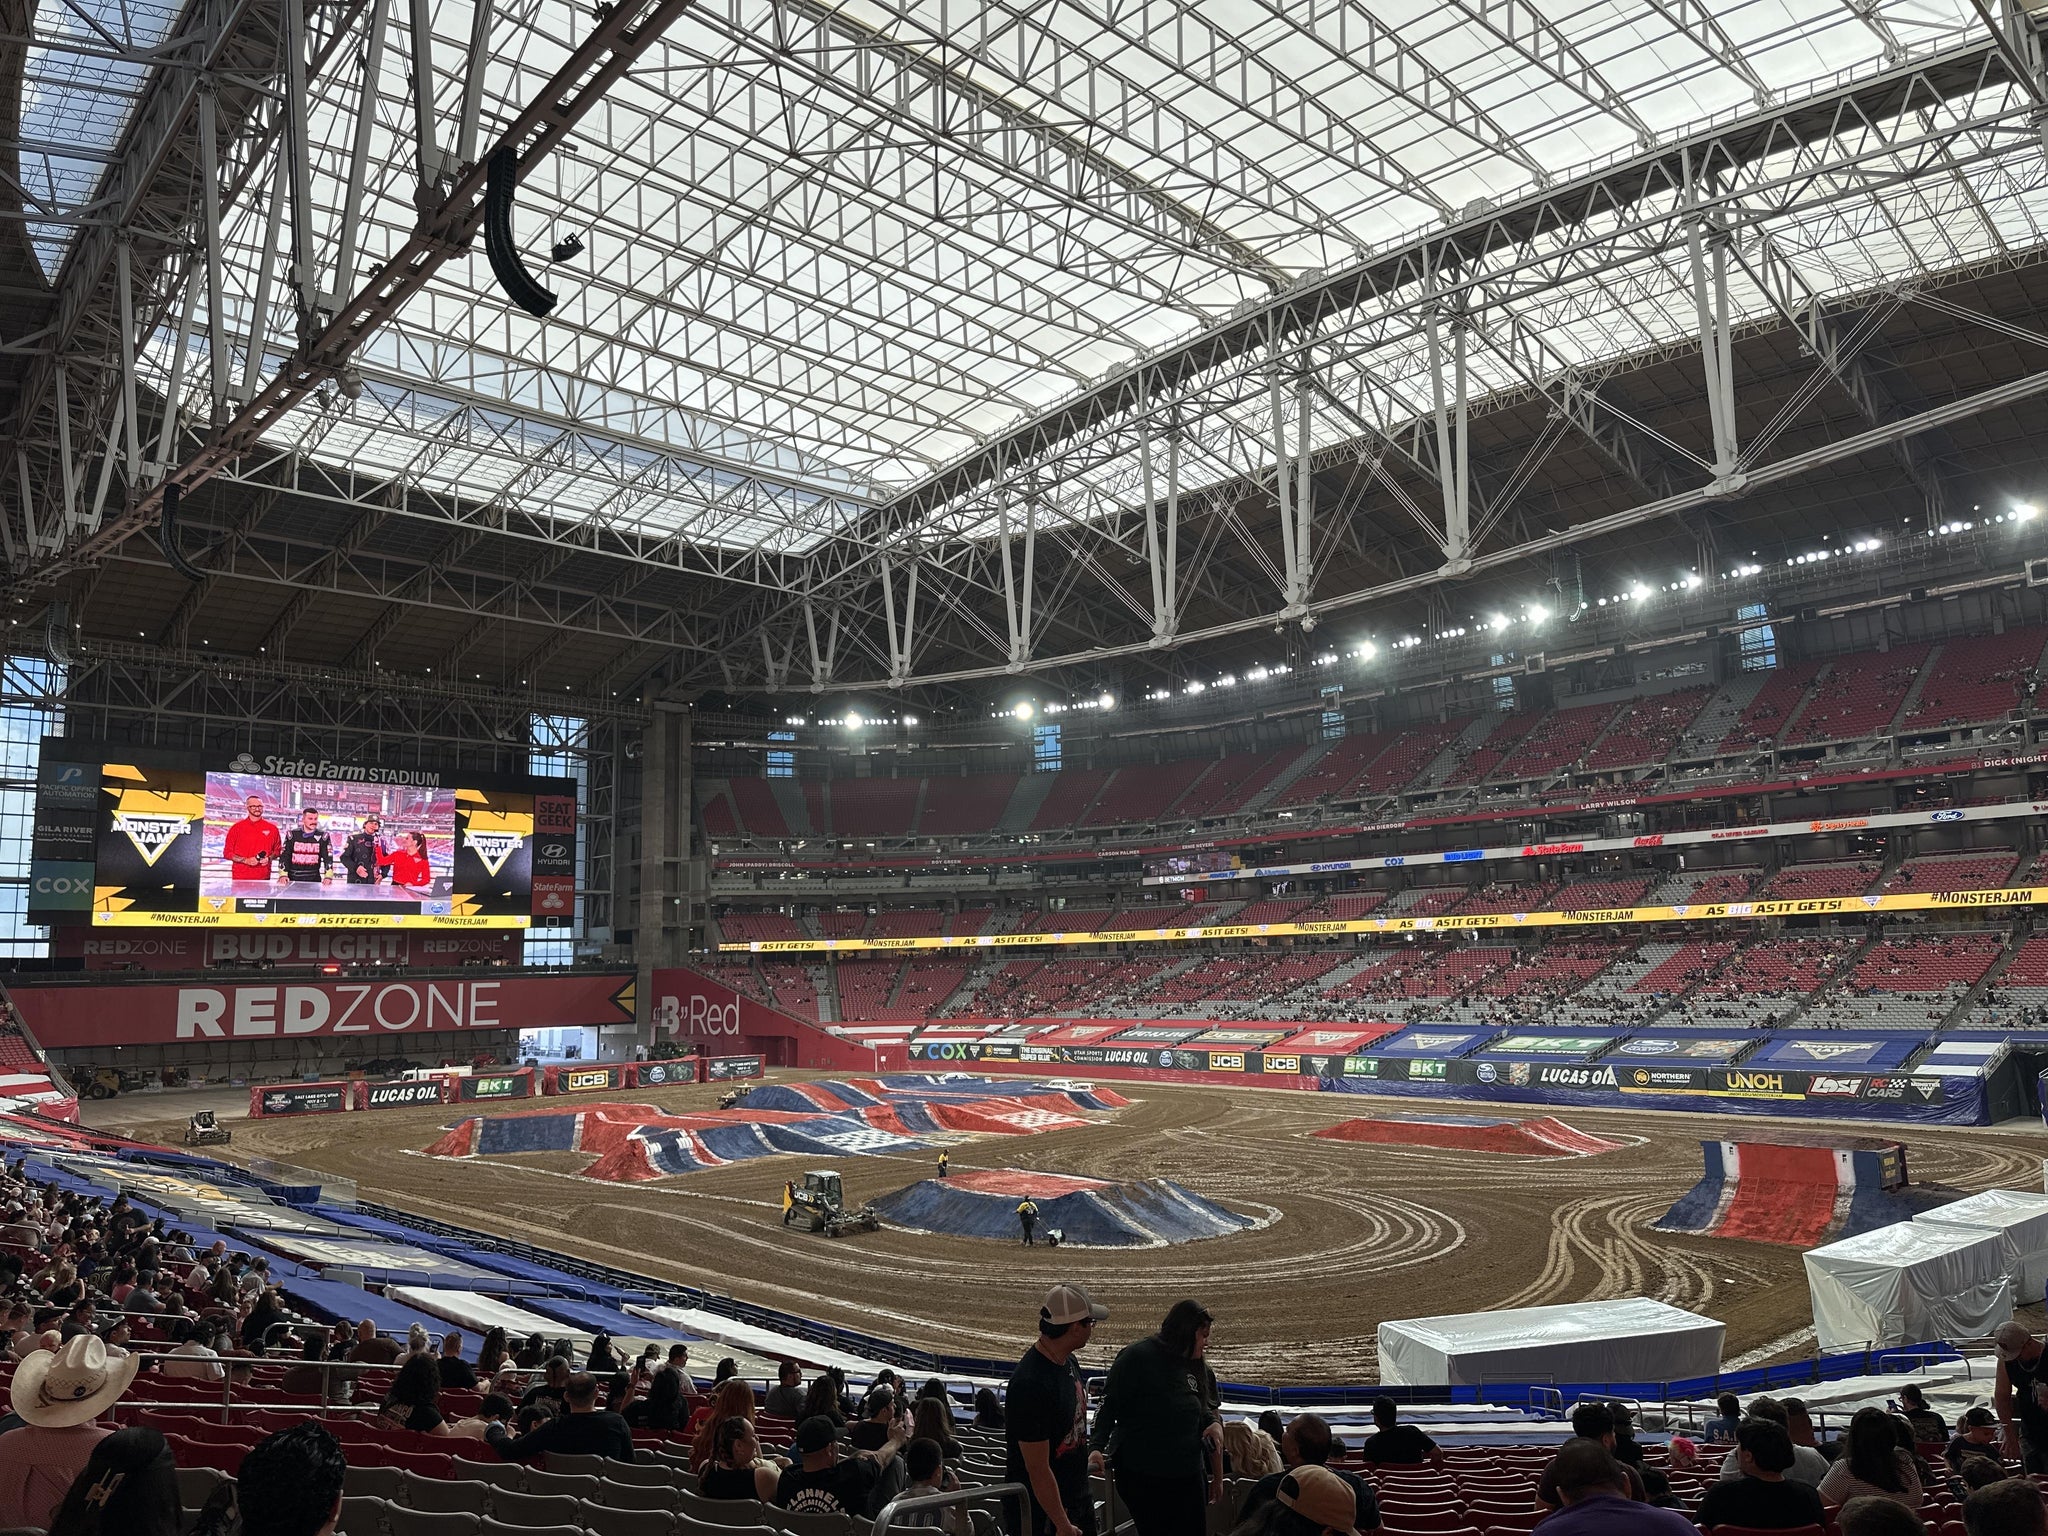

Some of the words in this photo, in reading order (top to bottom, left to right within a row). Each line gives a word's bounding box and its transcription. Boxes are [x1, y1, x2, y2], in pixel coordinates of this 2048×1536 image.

[1984, 759, 2009, 767] DICK
[2011, 755, 2048, 765] (NIGHT
[368, 768, 440, 787] STADIUM
[40, 783, 68, 792] PACIFIC
[43, 790, 95, 799] AUTOMATION
[538, 802, 572, 816] SEAT
[1580, 802, 1605, 810] LARRY
[1607, 798, 1636, 807] WILSON
[538, 814, 572, 828] GEEK
[112, 820, 192, 836] MONSTER
[132, 833, 172, 845] JAM
[464, 837, 523, 850] MONSTER
[480, 848, 507, 858] JAM
[536, 858, 571, 866] HYUNDAI
[1384, 857, 1404, 866] COX
[36, 877, 90, 895] COX
[1930, 890, 2032, 904] #MONSTERJAM
[1706, 906, 1725, 916] AS
[1728, 904, 1752, 915] BIG
[1755, 902, 1775, 914] AS
[1778, 902, 1791, 912] IT
[1797, 900, 1842, 912] GETS!
[150, 914, 220, 924] #MONSTERJAM
[319, 916, 336, 924] AS
[336, 916, 348, 924] IT
[350, 916, 380, 925] GETS!
[433, 916, 488, 926] #MONSTERJAM
[1562, 910, 1634, 922] #MONSTERJAM
[1294, 922, 1347, 933] #MONSTERJAM
[1400, 920, 1414, 929] AS
[1436, 918, 1450, 927] AS
[1452, 918, 1463, 926] IT
[1465, 916, 1499, 926] GETS!
[1089, 932, 1136, 940] #MONSTERJAM
[1202, 928, 1213, 936] AS
[1224, 928, 1248, 936] GETS!
[83, 939, 188, 955] REDZONE
[212, 934, 294, 960] BUD
[298, 934, 403, 960] LIGHT
[423, 939, 502, 953] REDZONE
[863, 938, 916, 948] #MONSTERJAM
[176, 982, 501, 1038] REDZONE
[690, 994, 740, 1036] Red
[927, 1044, 967, 1060] COX
[1105, 1050, 1132, 1062] LUCAS
[1133, 1052, 1149, 1064] OIL
[1212, 1056, 1242, 1068] JCB
[1266, 1058, 1297, 1070] JCB
[1344, 1058, 1378, 1072] BKT
[1409, 1061, 1446, 1076] BKT
[572, 1074, 605, 1086] JCB
[1540, 1068, 1590, 1084] LUCAS
[1726, 1072, 1784, 1090] UNOH
[478, 1080, 512, 1092] BKT
[1870, 1079, 1888, 1088] RC
[370, 1088, 415, 1104] LUCAS
[416, 1086, 438, 1100] OIL
[1866, 1088, 1904, 1098] CARS
[794, 1190, 808, 1202] JCB
